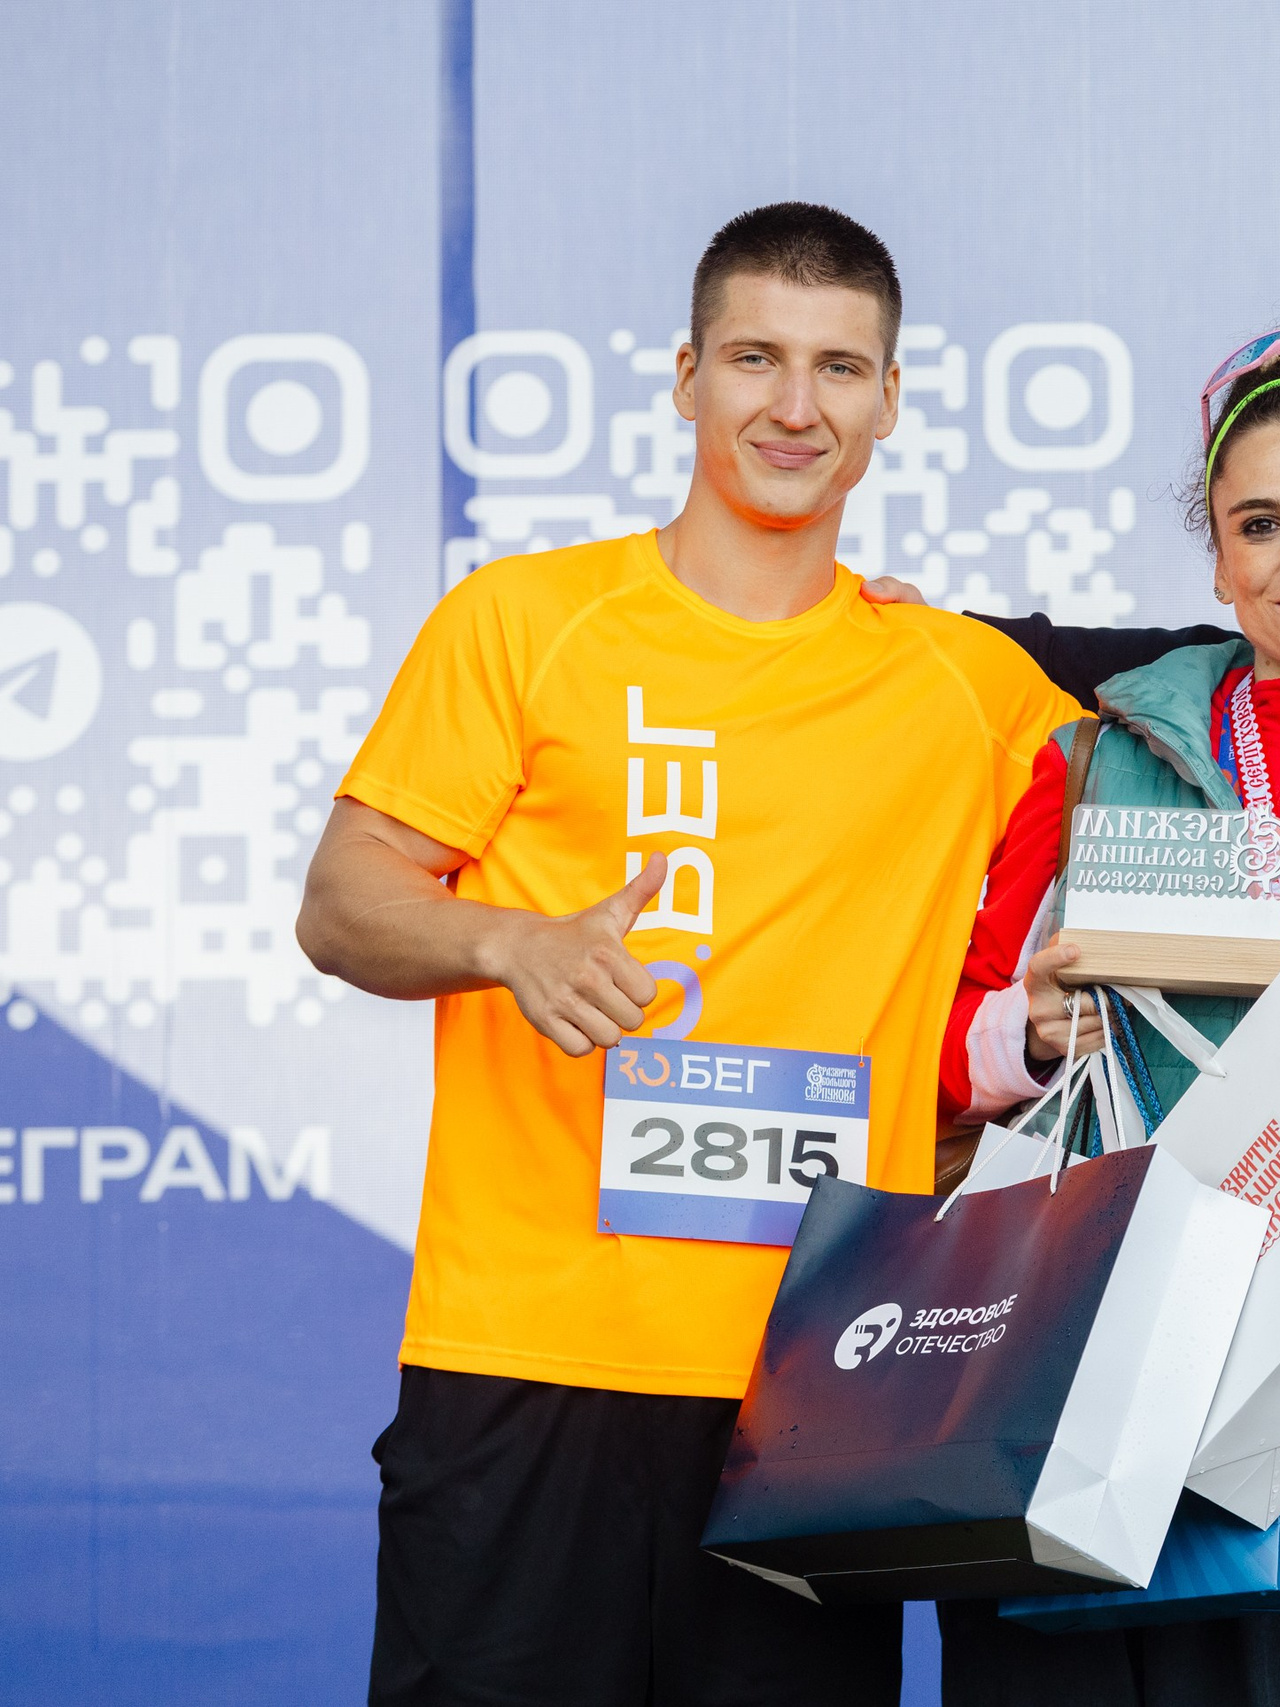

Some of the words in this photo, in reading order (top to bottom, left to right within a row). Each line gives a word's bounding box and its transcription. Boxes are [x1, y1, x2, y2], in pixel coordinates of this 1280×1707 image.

[629, 1115, 840, 1187] 2815
[908, 1293, 1019, 1330] ЗДОРОВОЕ
[895, 1323, 1007, 1356] ОТЕЧЕСТВО
